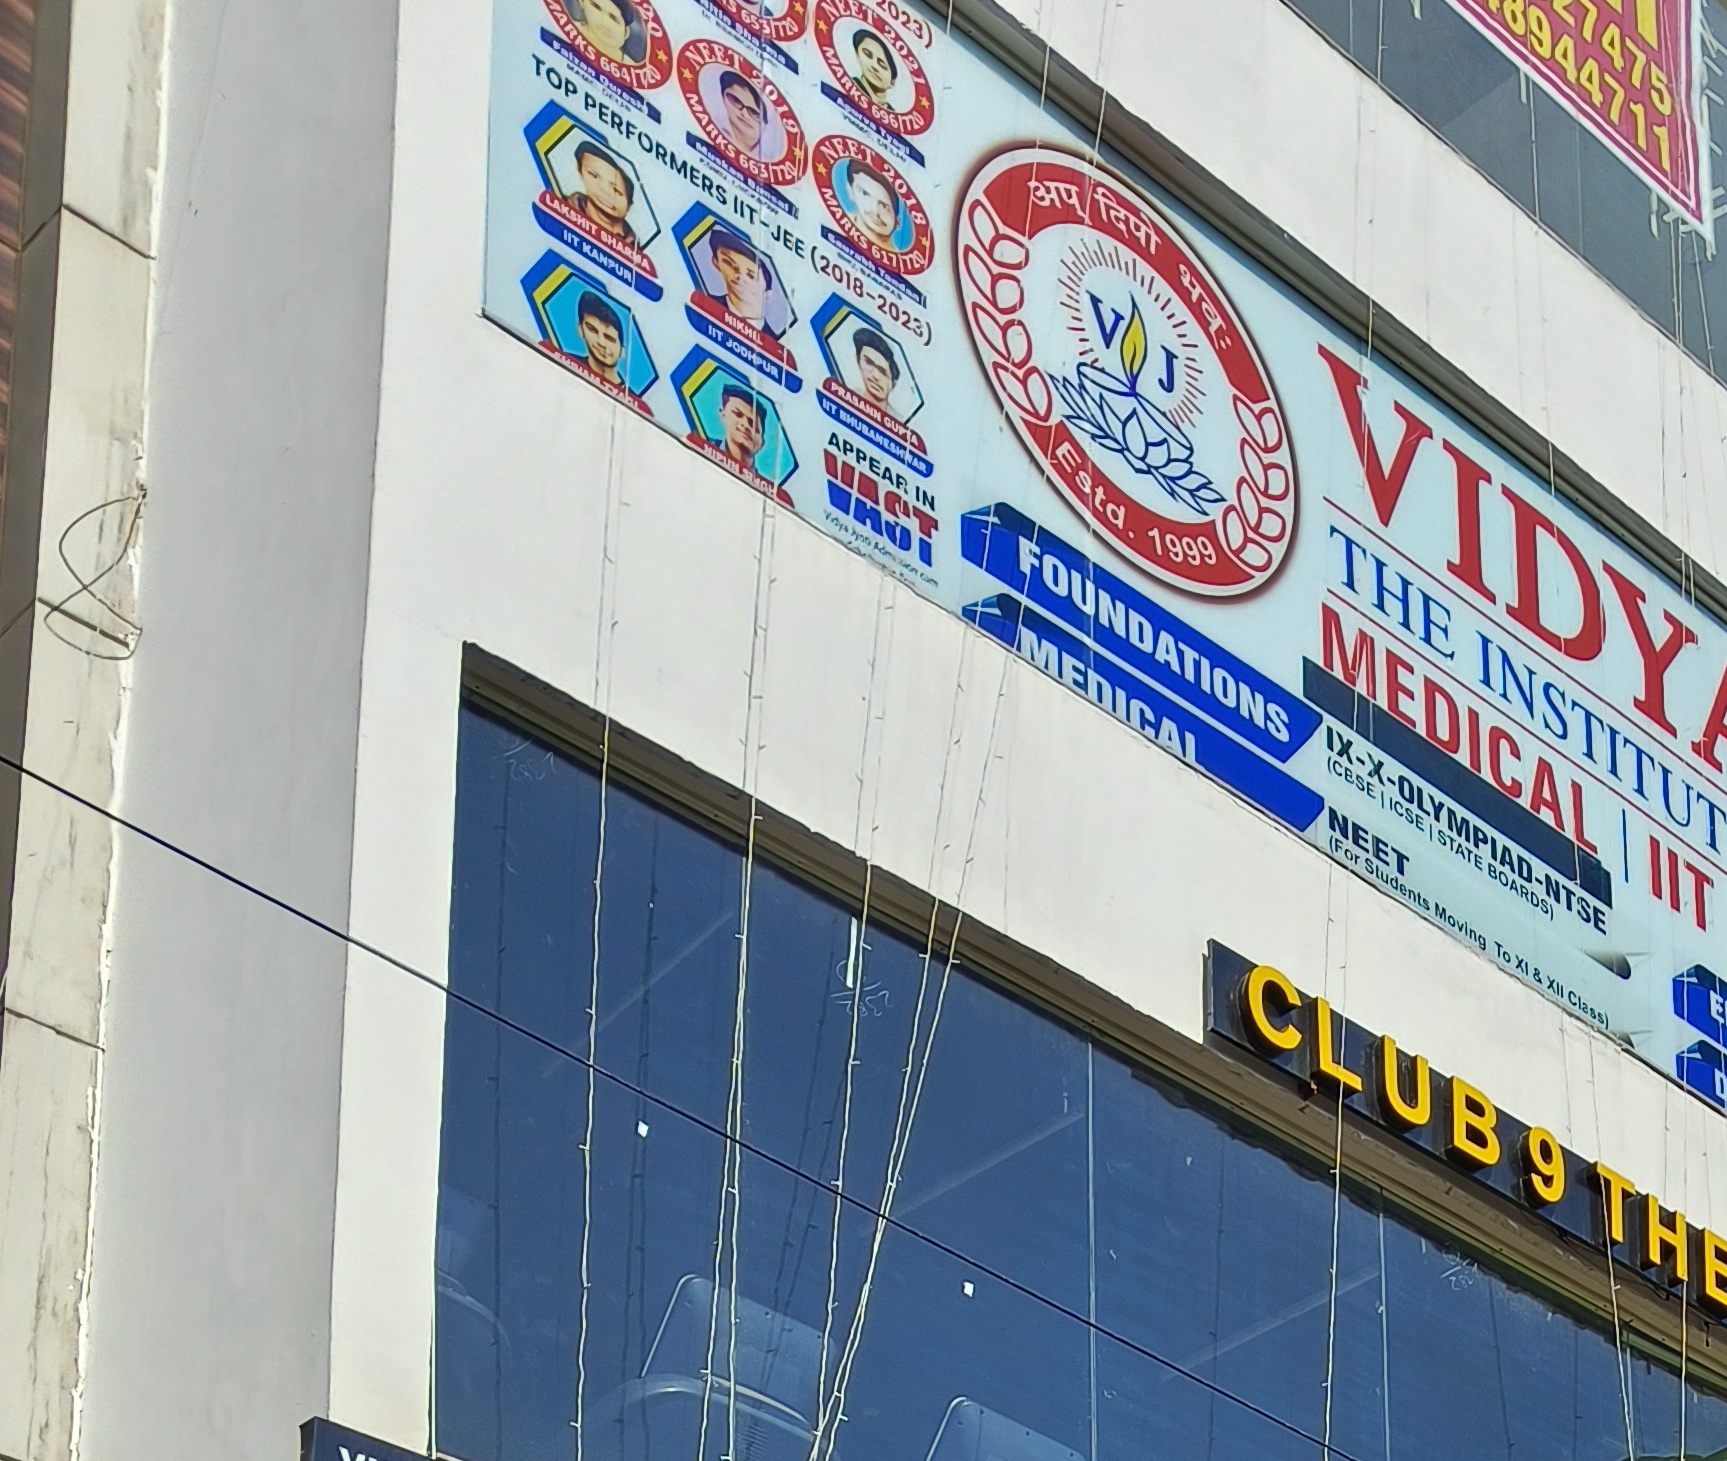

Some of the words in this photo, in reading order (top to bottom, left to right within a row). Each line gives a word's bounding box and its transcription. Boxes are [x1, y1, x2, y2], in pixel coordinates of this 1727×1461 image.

[531, 53, 579, 97] TOP
[584, 95, 727, 206] PERFORMERS
[733, 197, 805, 259] IIT-JEE
[828, 432, 908, 494] APPEAR
[915, 480, 935, 510] IN
[1054, 440, 1137, 540] Estd.
[1148, 527, 1217, 564] 1999
[1015, 533, 1292, 744] FOUNDATIONS
[1329, 526, 1456, 662] THE
[1321, 602, 1598, 855] MEDICAL
[1649, 837, 1714, 933] IIT
[1326, 725, 1608, 936] IX-X-OLYMPIAD-NTSE
[1327, 756, 1376, 800] (CBSE
[1389, 797, 1426, 833] ICSE
[1437, 831, 1484, 872] STATE
[1487, 865, 1554, 922] BOARDS)
[1328, 806, 1410, 877] NEET
[1246, 964, 1501, 1168] CLUB
[1526, 1127, 1566, 1204] 9
